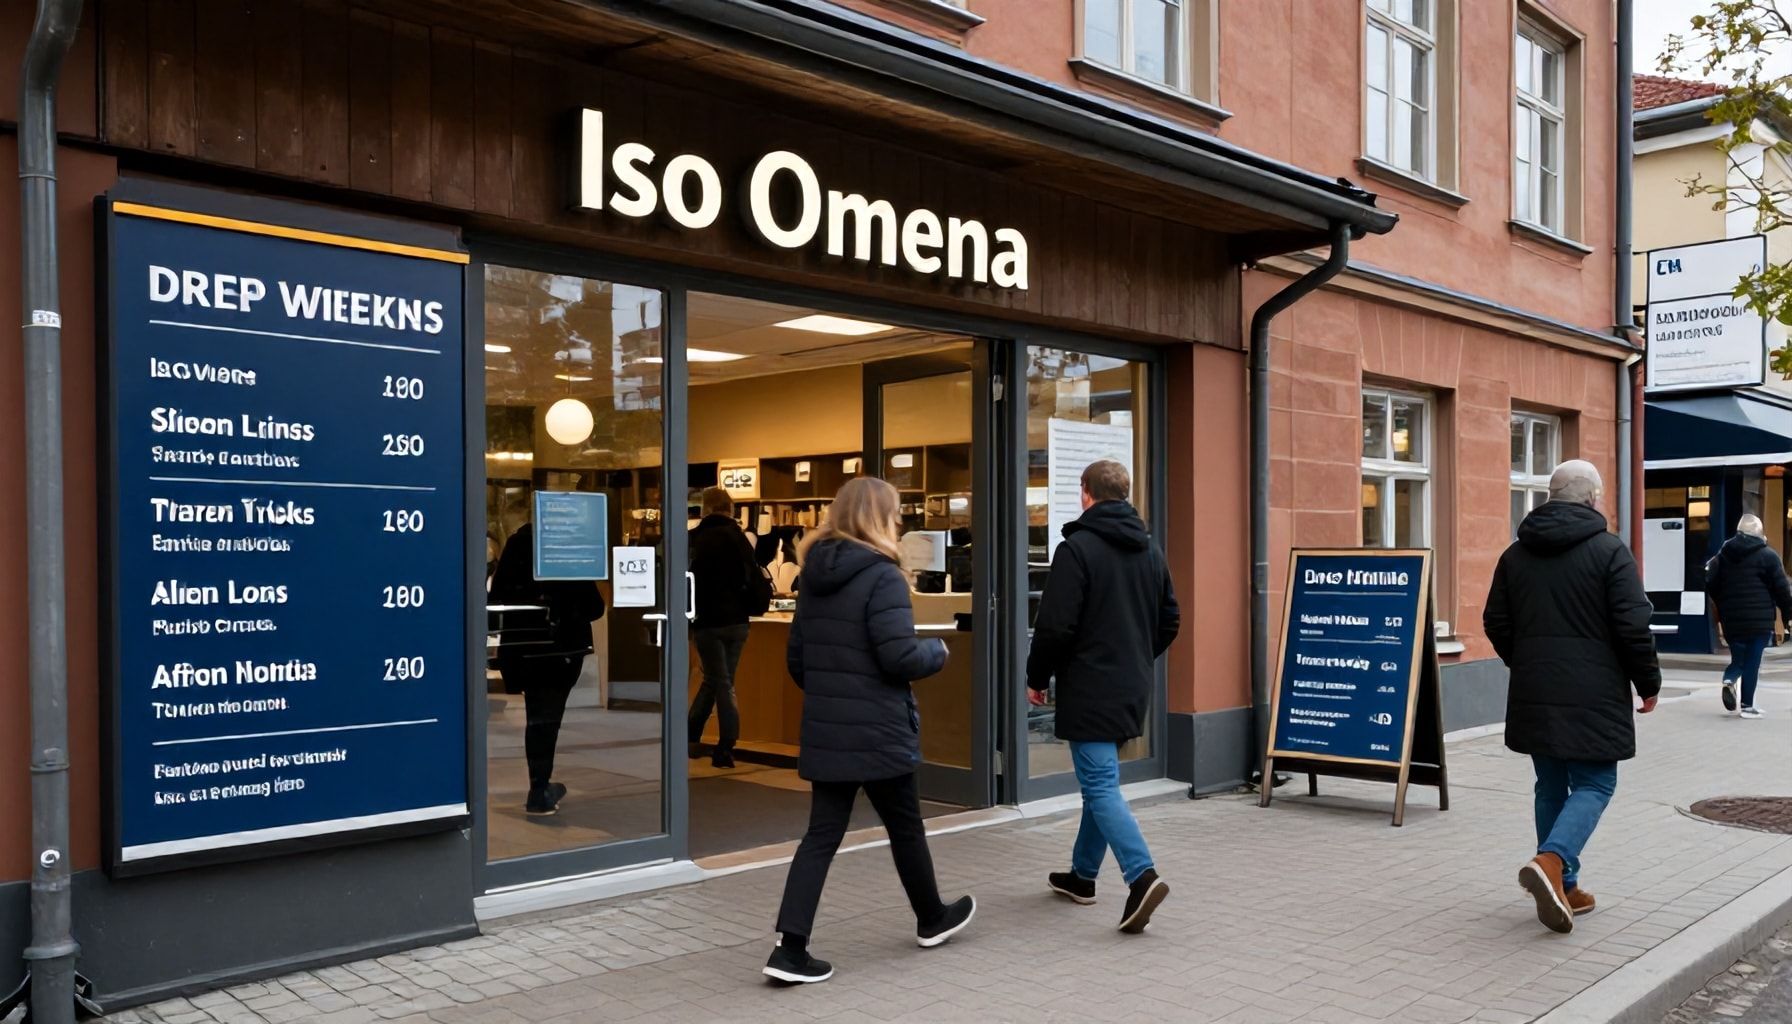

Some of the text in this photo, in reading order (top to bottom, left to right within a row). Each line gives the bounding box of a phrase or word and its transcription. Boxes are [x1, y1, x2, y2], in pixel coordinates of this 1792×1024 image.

[581, 108, 1029, 290] Iso Omena
[149, 264, 267, 313] DREP
